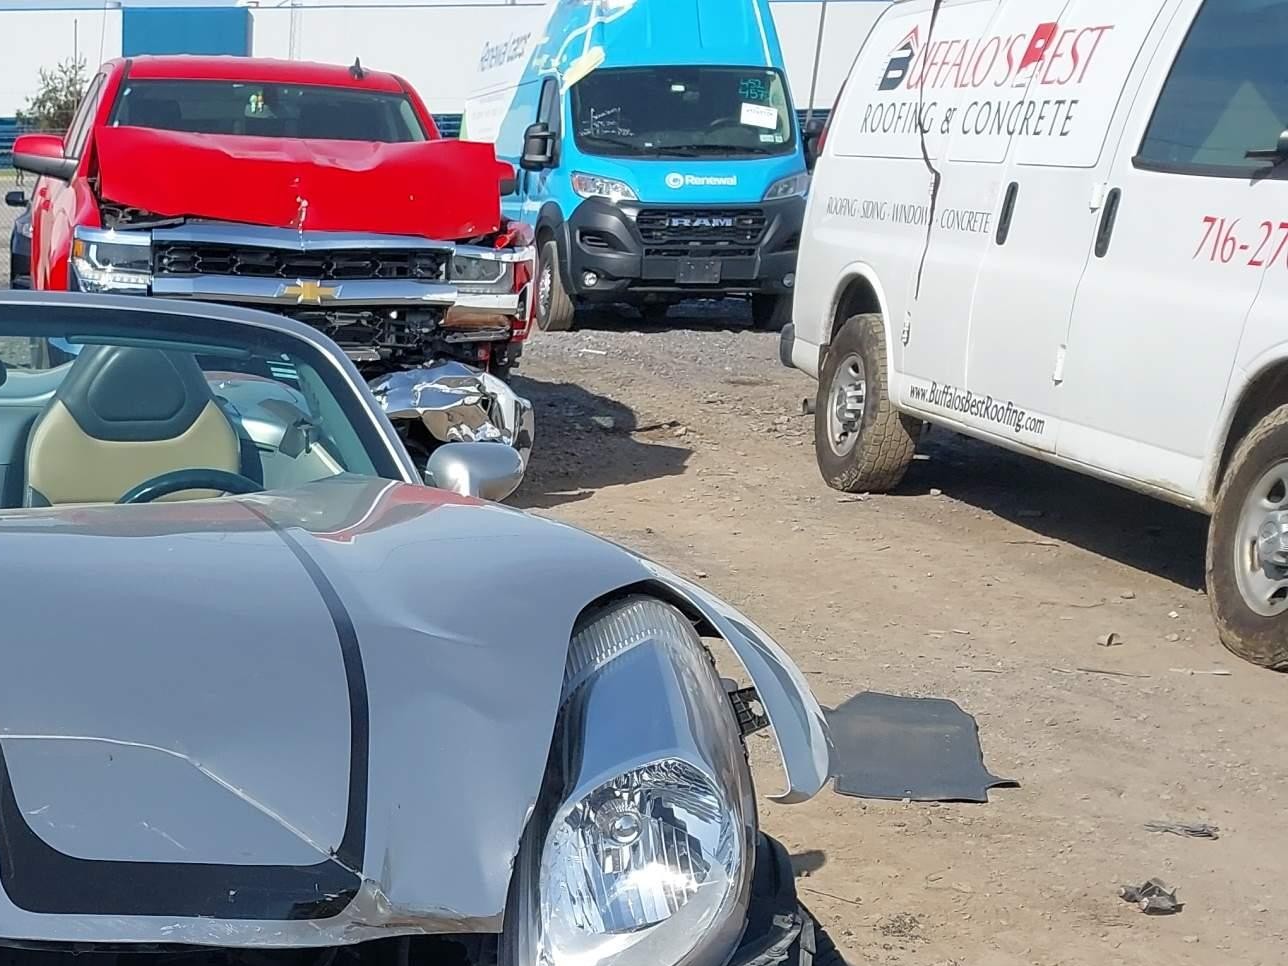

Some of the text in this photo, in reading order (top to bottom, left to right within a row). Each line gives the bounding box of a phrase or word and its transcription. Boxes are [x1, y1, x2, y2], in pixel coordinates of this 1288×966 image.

[860, 99, 1080, 137] ROOFING & CONCRETE
[684, 175, 738, 186] Renewal
[670, 217, 733, 228] RAM
[940, 208, 993, 234] CONCRETE
[1192, 216, 1288, 269] 716-27
[909, 381, 1046, 434] www.BuffalosBestRoofing.com
